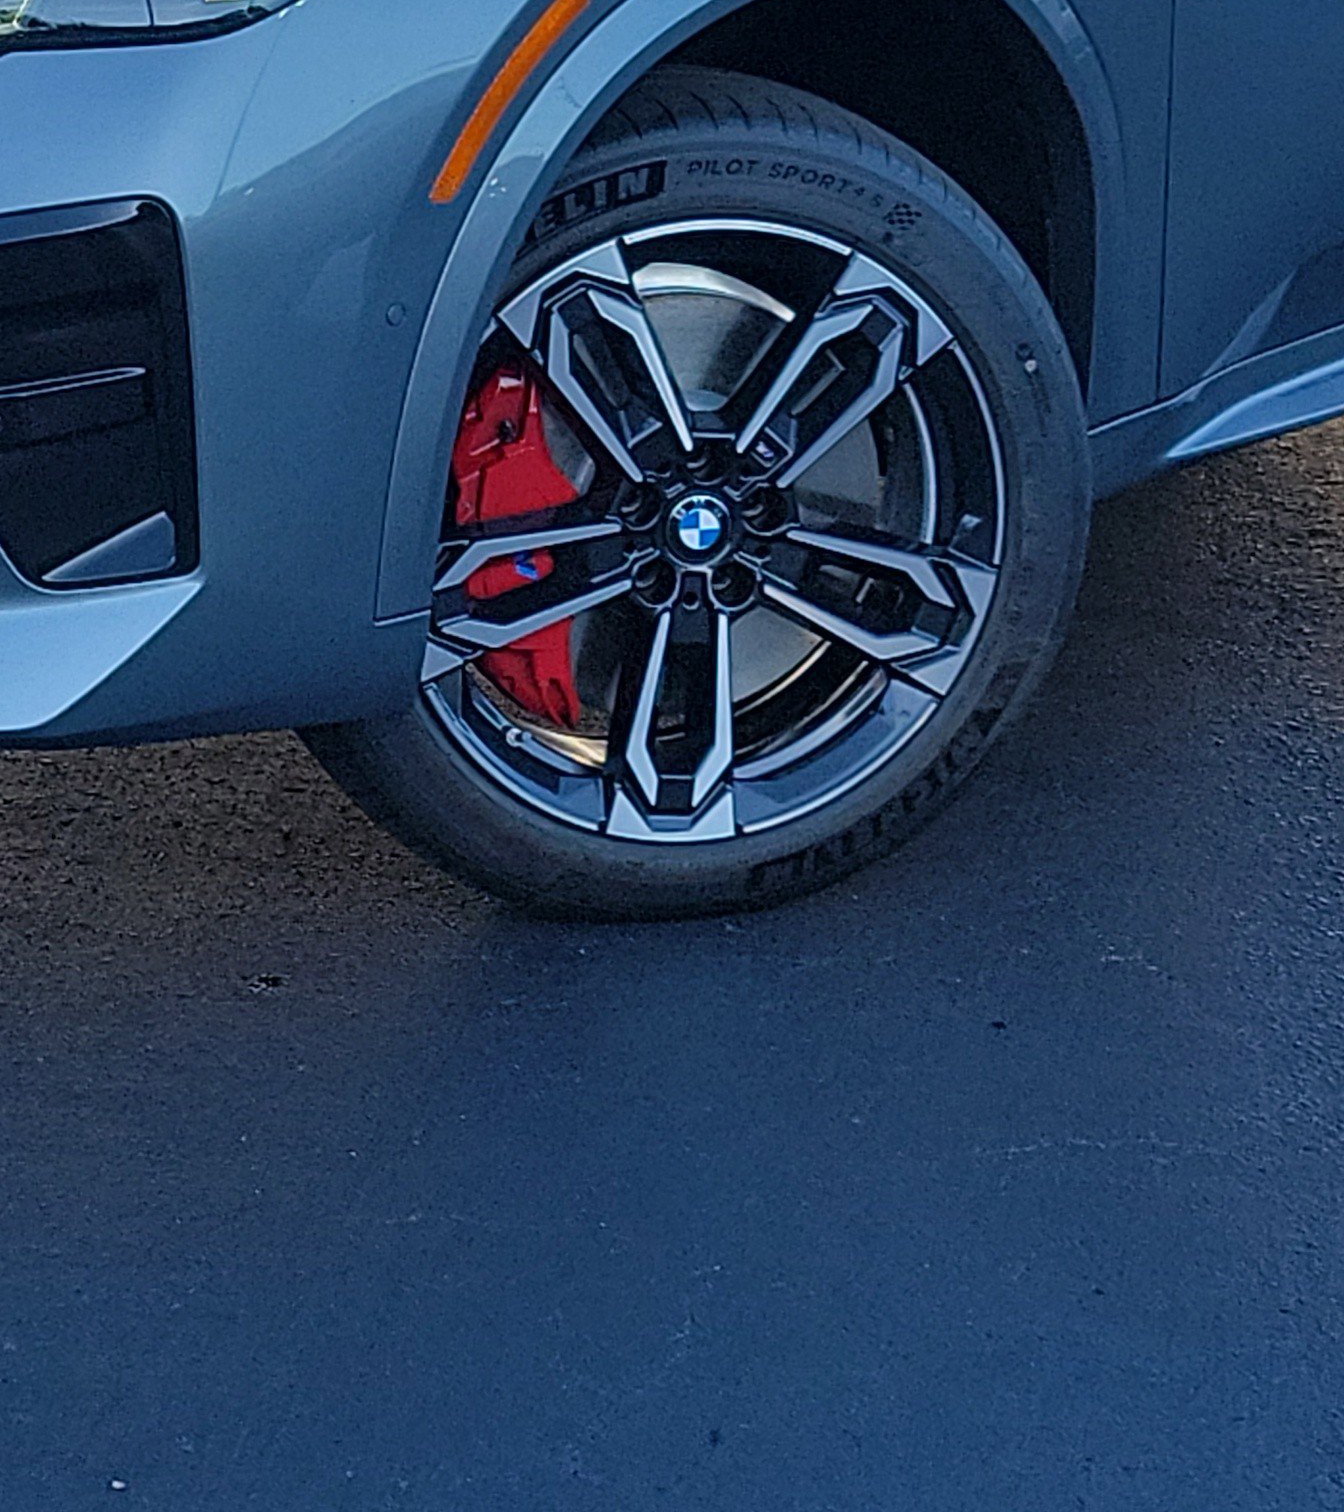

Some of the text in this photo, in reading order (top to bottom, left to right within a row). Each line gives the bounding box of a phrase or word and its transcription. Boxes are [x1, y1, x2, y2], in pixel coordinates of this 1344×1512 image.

[687, 159, 759, 176] PILOT
[768, 162, 855, 194] SPORT
[534, 168, 651, 238] ELIN
